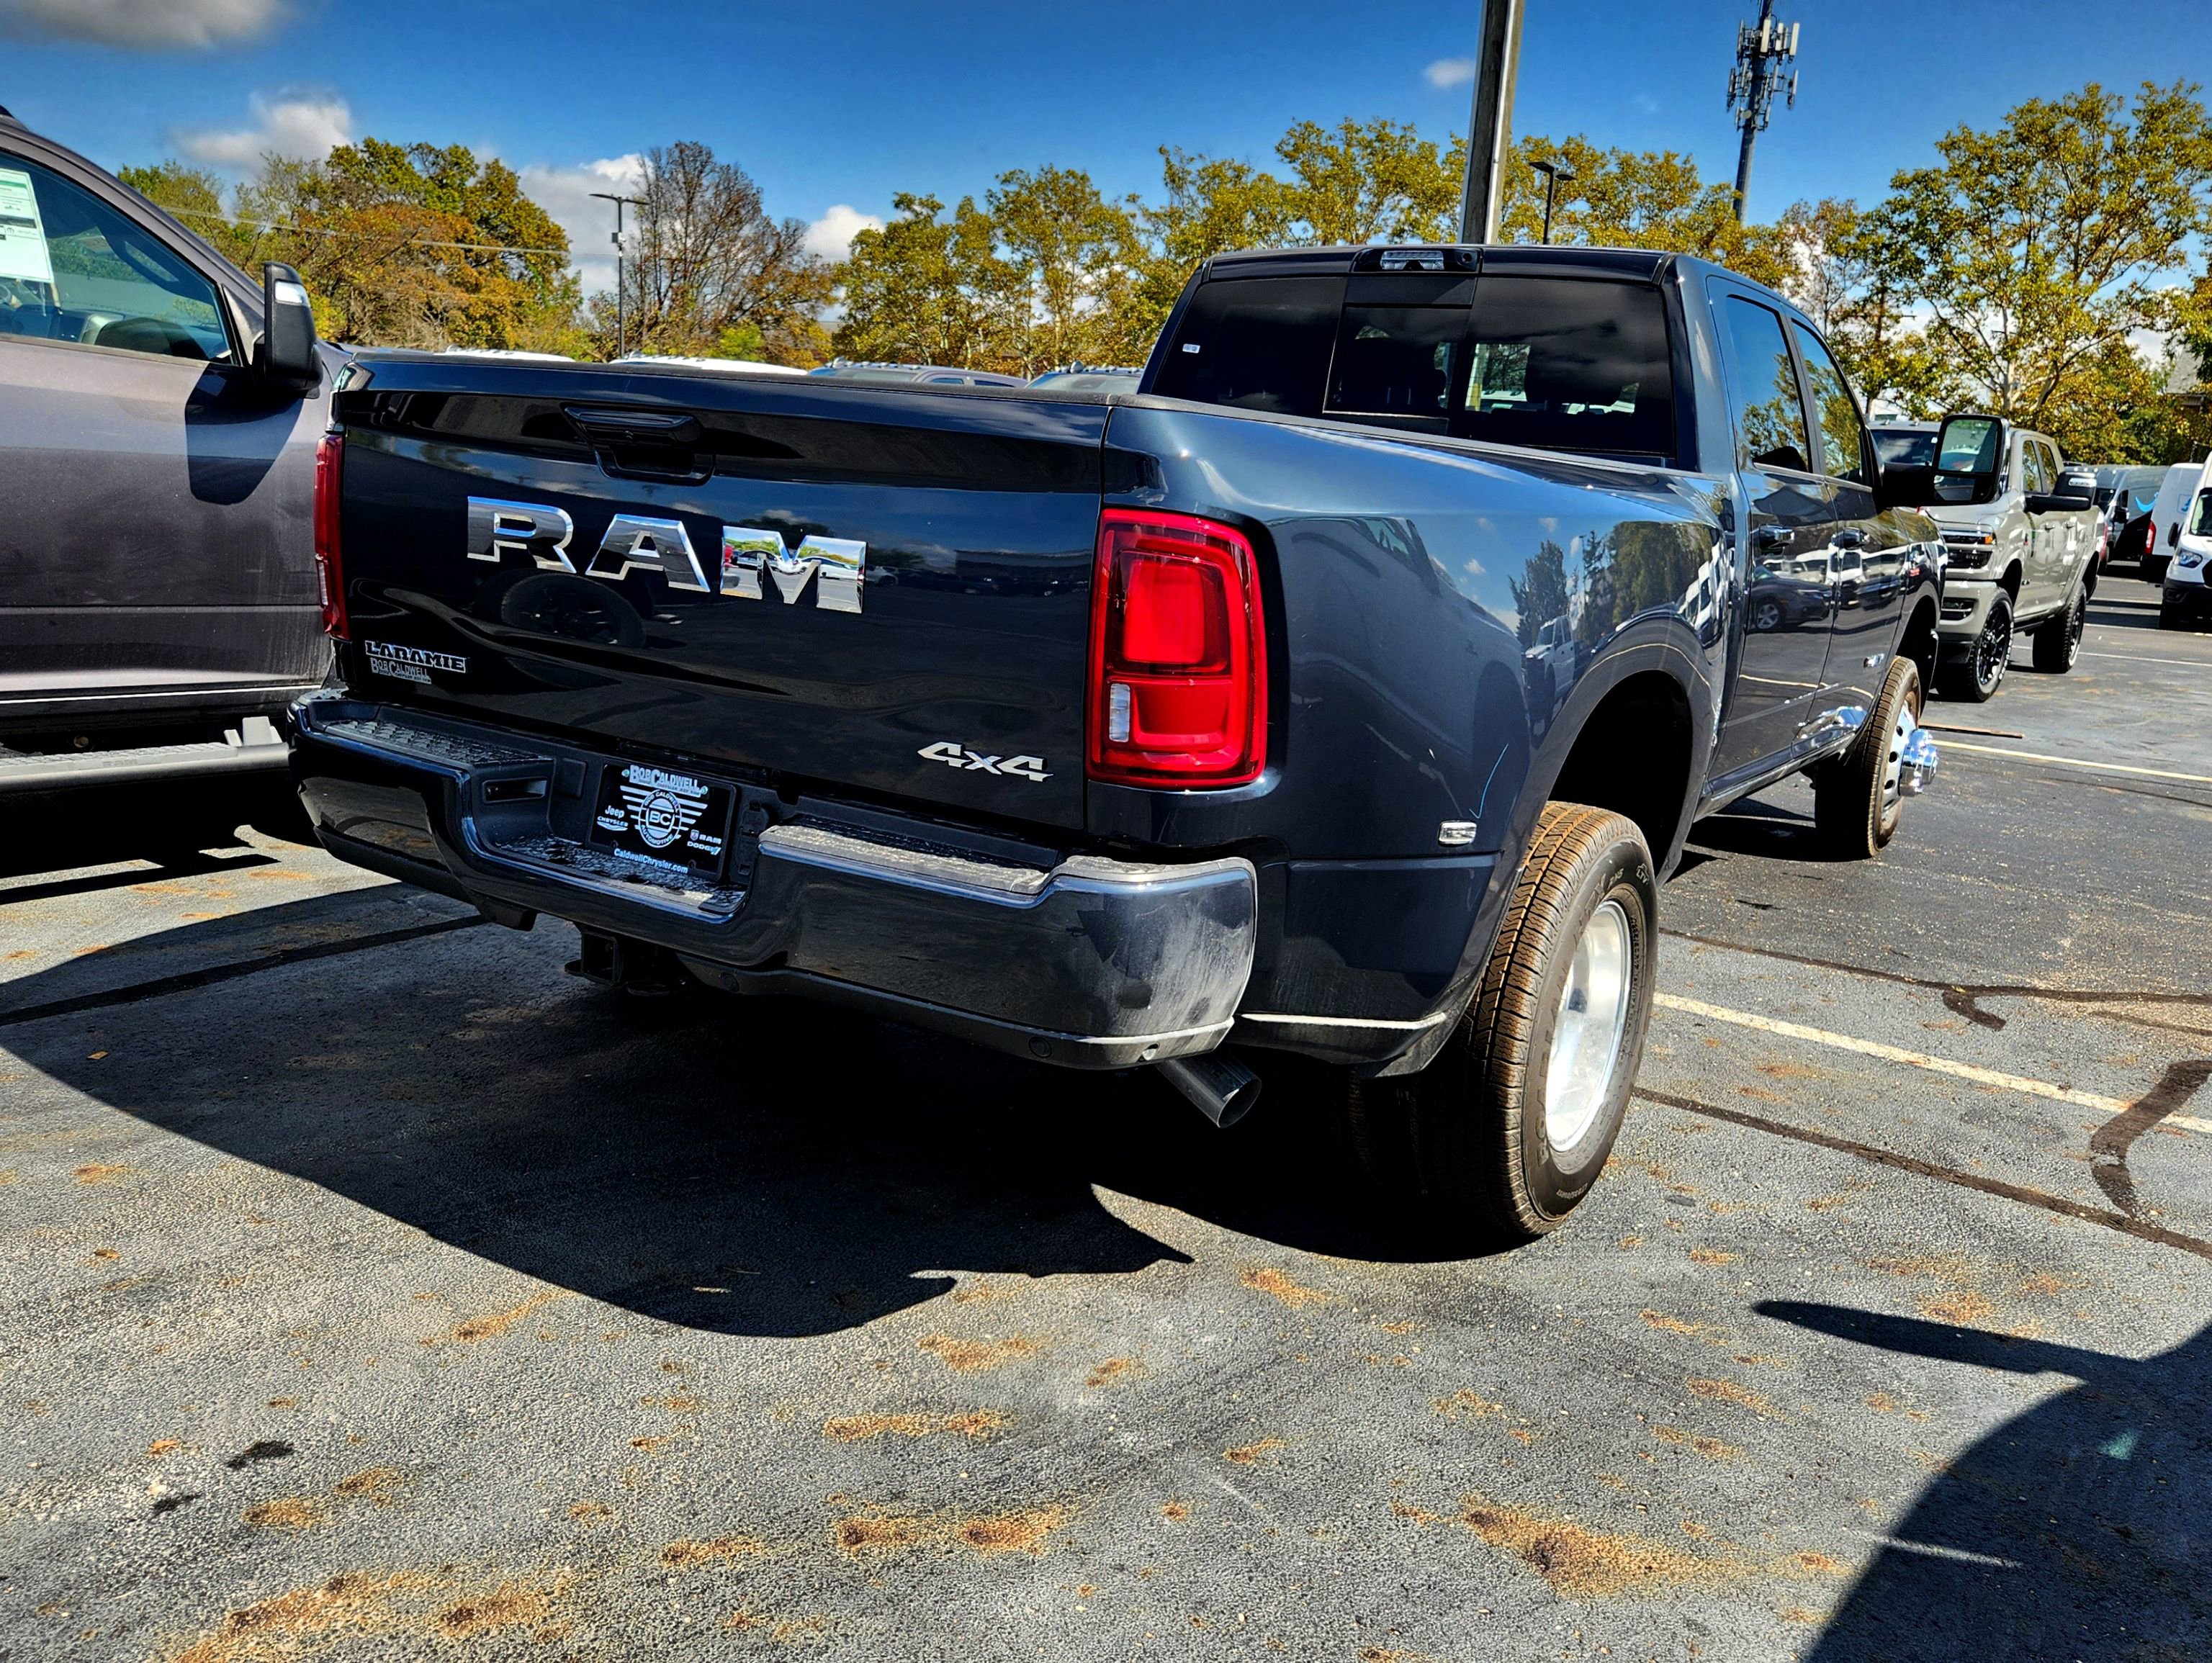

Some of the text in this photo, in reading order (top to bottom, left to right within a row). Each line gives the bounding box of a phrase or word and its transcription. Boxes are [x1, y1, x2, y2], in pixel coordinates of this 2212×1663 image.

[467, 496, 866, 614] RAM
[365, 640, 467, 673] LARAMIE
[370, 657, 388, 674] BOB
[389, 661, 428, 678] CALDWELL
[629, 765, 700, 791] BOB CALDWELL
[605, 805, 625, 819] Jeep
[655, 792, 679, 814] CALDWELL
[597, 816, 629, 827] CHRYSLER
[649, 811, 672, 826] BC
[641, 824, 674, 846] AUTOMOTIVE
[698, 834, 721, 844] RAM
[613, 848, 688, 874] CaldwellChrysler.com
